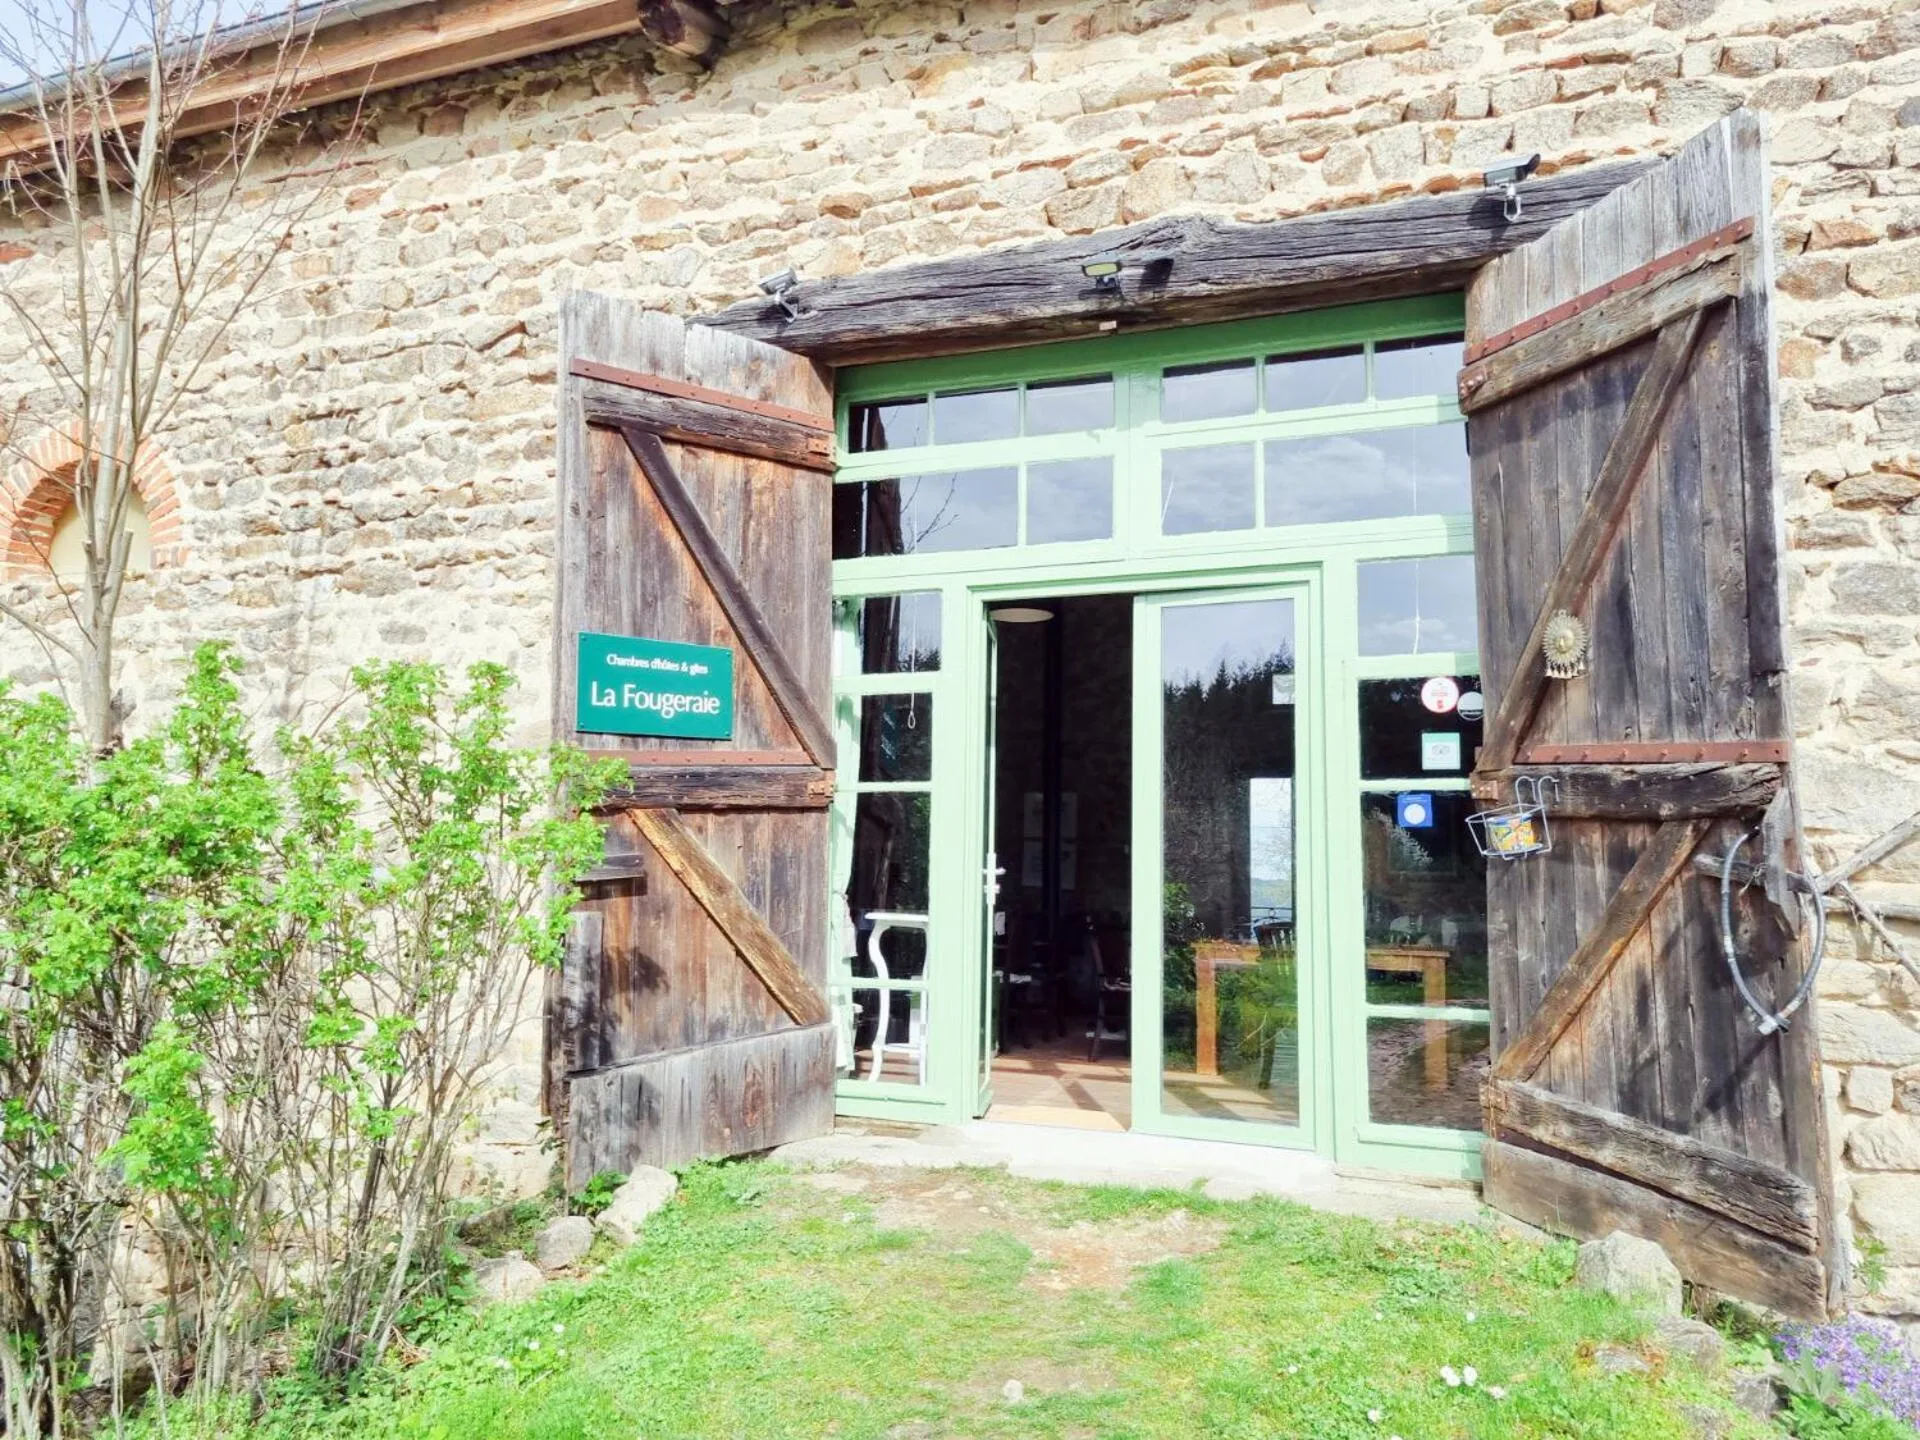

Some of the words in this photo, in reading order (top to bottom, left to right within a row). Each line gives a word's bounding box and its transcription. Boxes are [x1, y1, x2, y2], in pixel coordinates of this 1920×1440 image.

[606, 653, 649, 669] Chambres
[680, 661, 688, 672] &
[591, 681, 617, 707] La
[623, 683, 720, 719] Fougeraie
